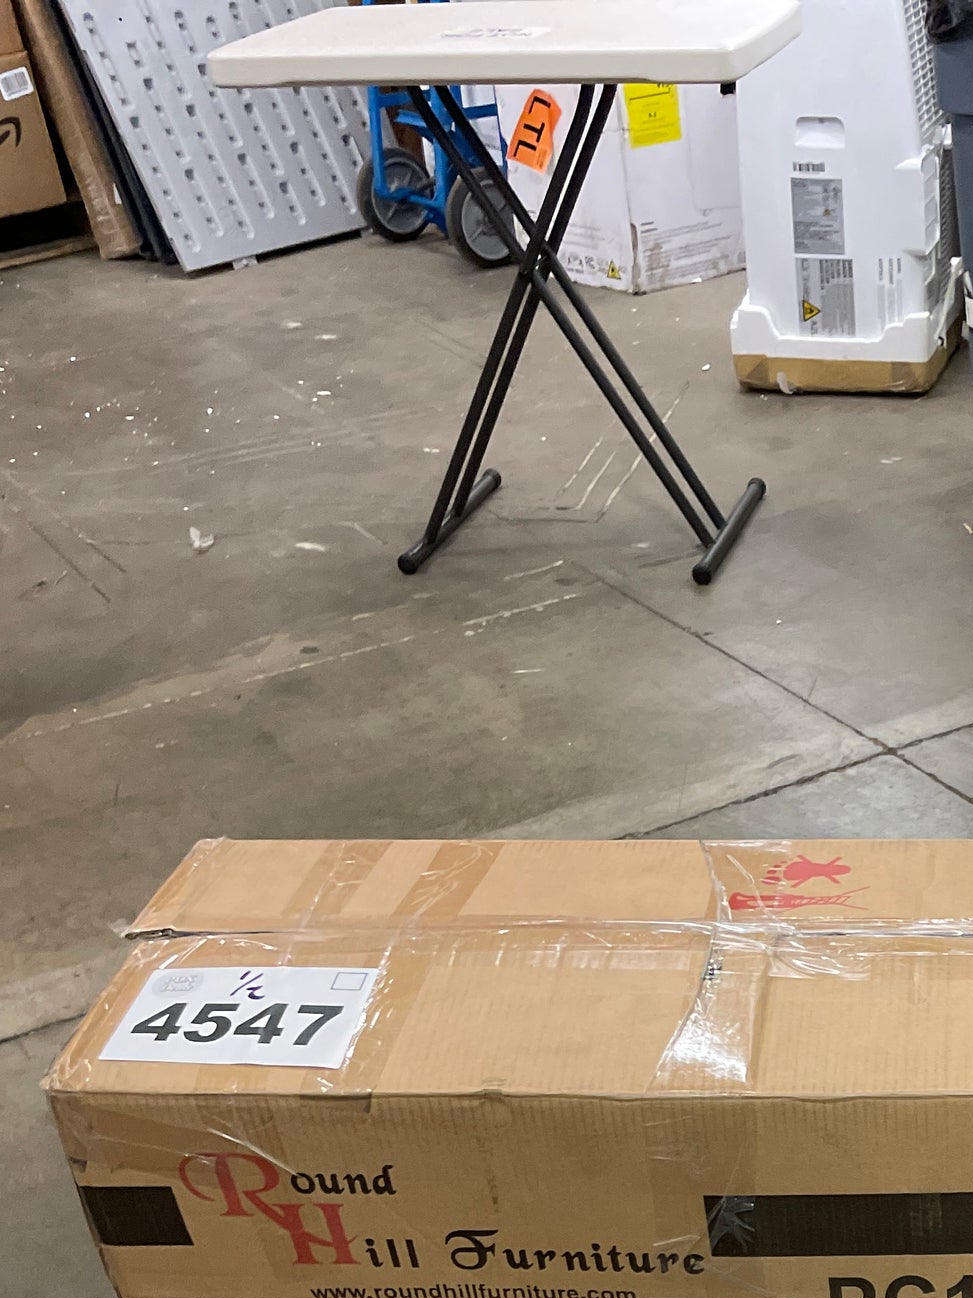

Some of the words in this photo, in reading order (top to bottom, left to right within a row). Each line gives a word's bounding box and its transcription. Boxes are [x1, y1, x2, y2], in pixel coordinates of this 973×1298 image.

[513, 96, 551, 157] LTL
[130, 1002, 345, 1046] 4547
[178, 1152, 397, 1222] Round
[275, 1202, 420, 1267] Hill
[444, 1229, 707, 1275] Furniture
